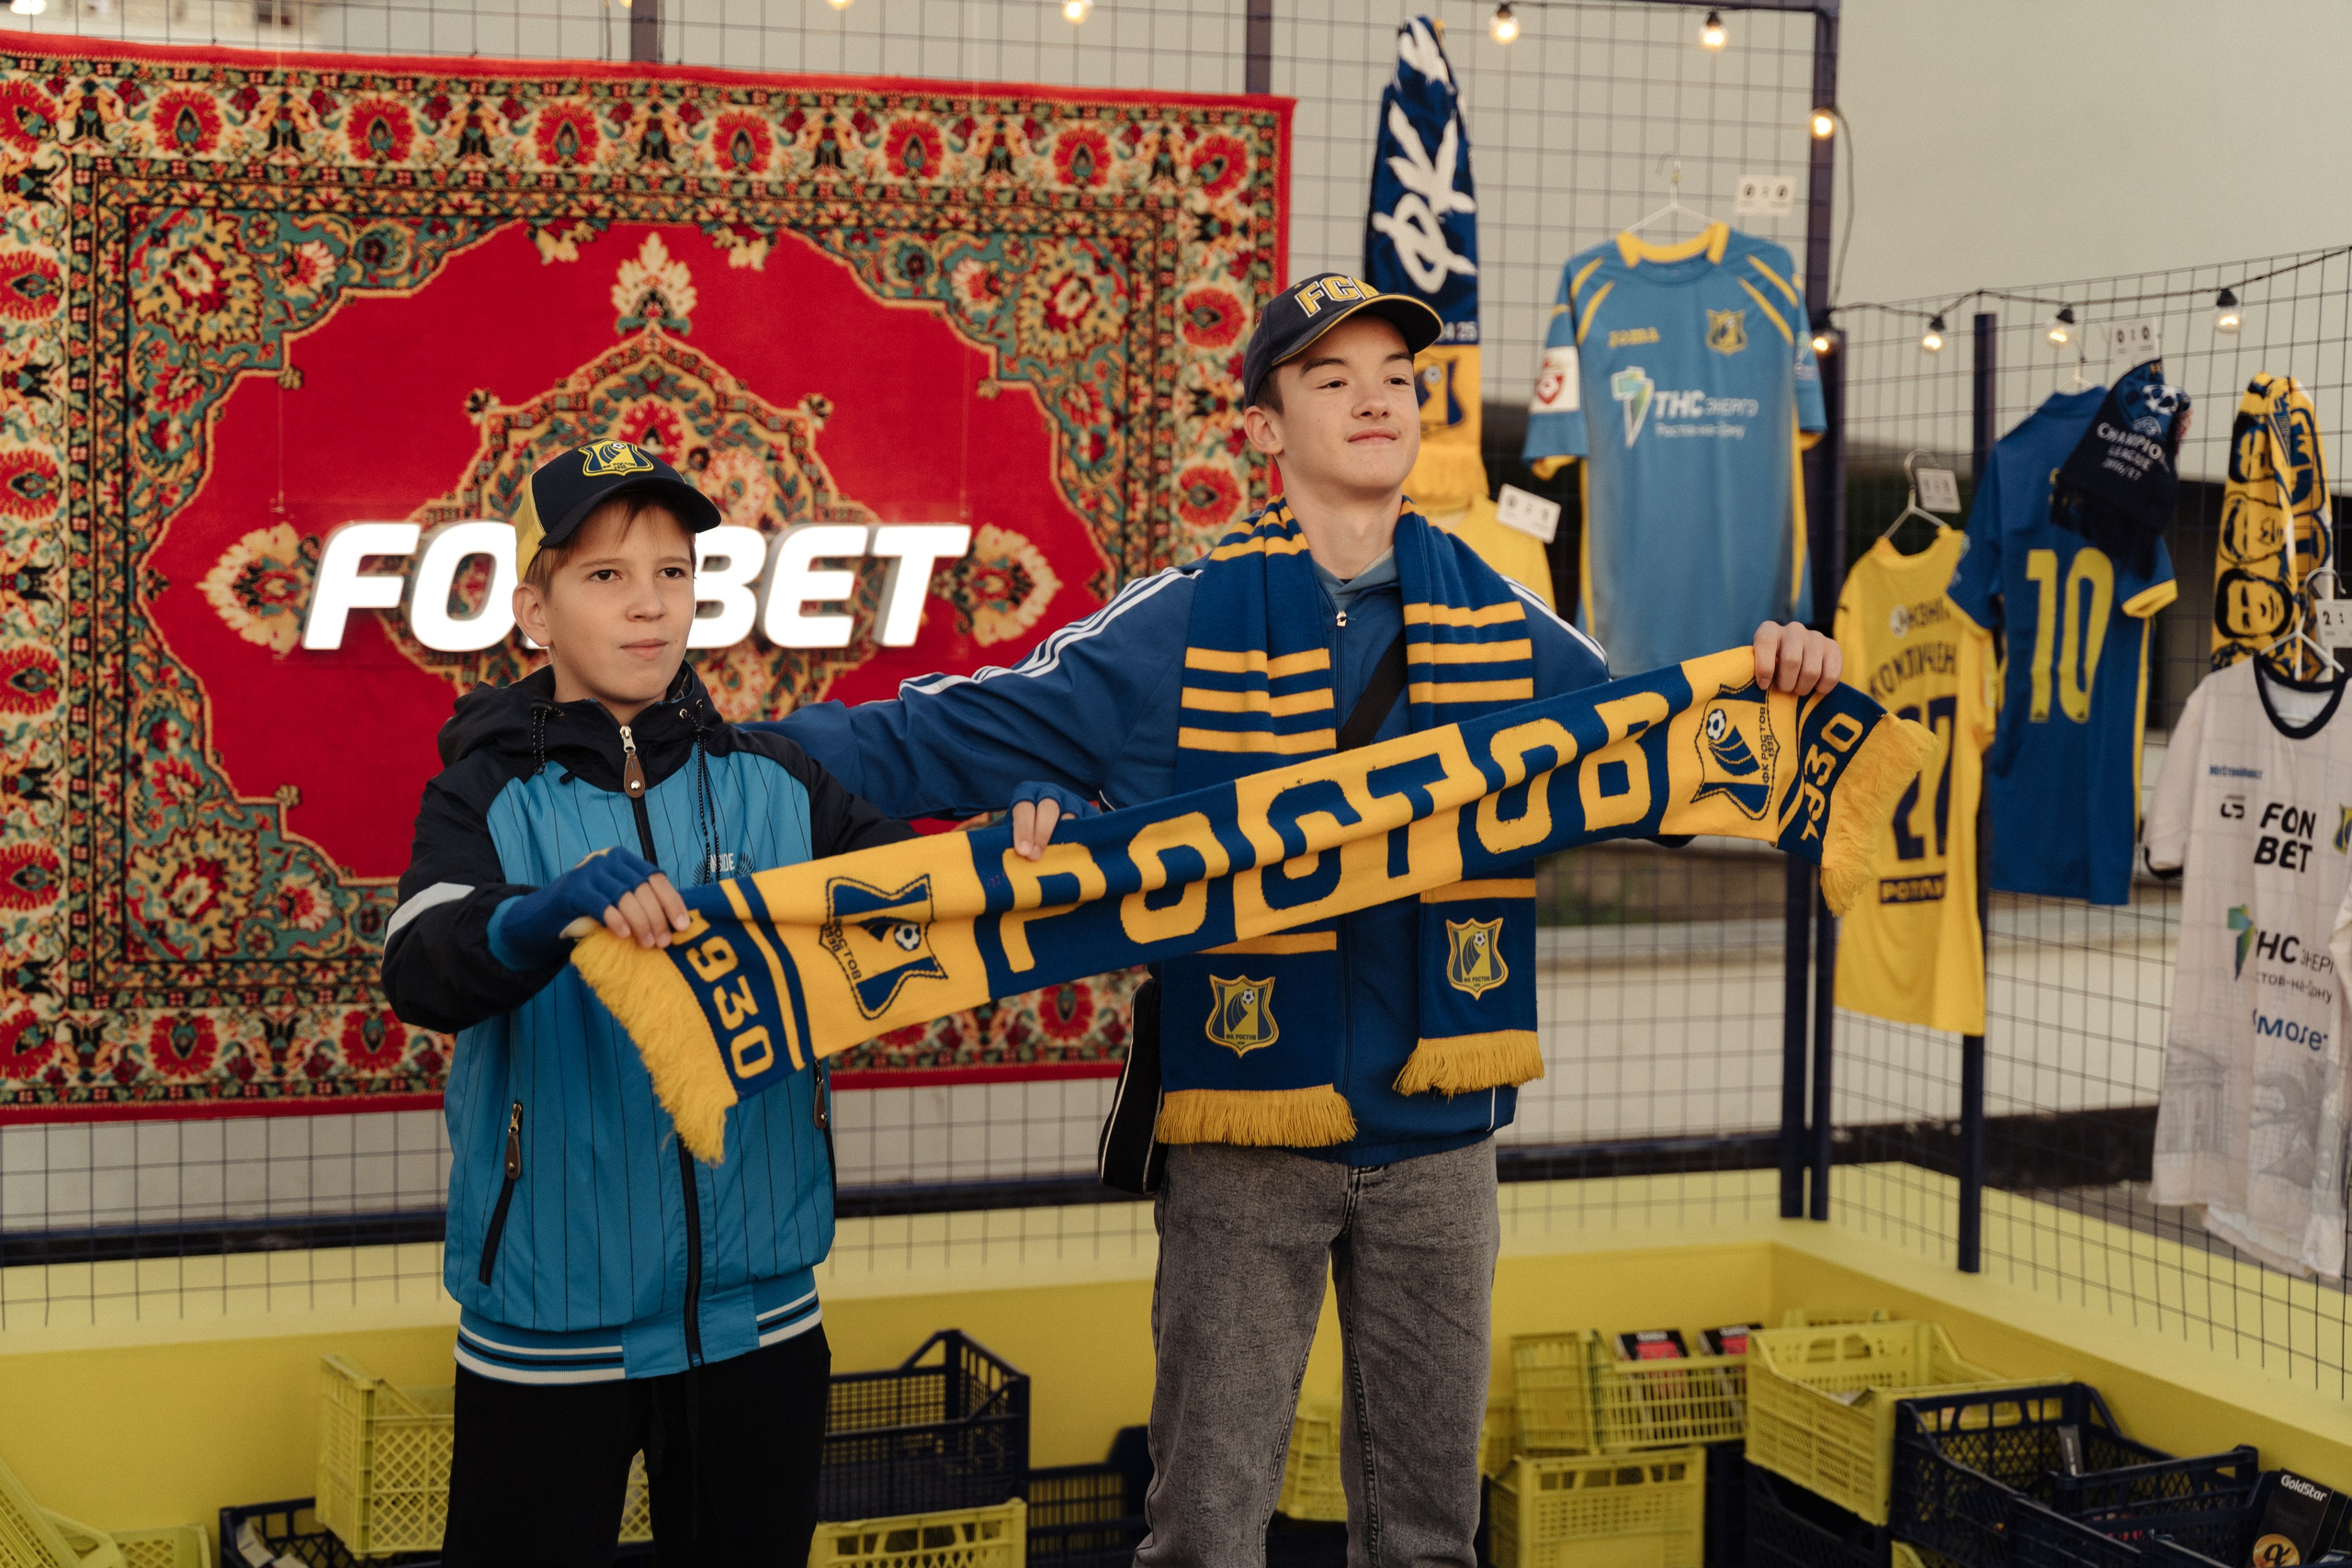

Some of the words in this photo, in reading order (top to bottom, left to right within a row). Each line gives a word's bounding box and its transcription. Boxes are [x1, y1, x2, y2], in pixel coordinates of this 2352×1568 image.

[302, 520, 971, 652] FOBET
[2026, 546, 2115, 724] 10
[2323, 611, 2332, 626] 2
[1758, 706, 1769, 761] РОСТОВ
[1761, 763, 1770, 783] ФК
[999, 691, 1670, 974] РОСТОВ
[2259, 802, 2317, 840] FON
[2254, 835, 2313, 873] BET
[2255, 929, 2301, 964] НС
[2280, 1473, 2328, 1502] GoldStar
